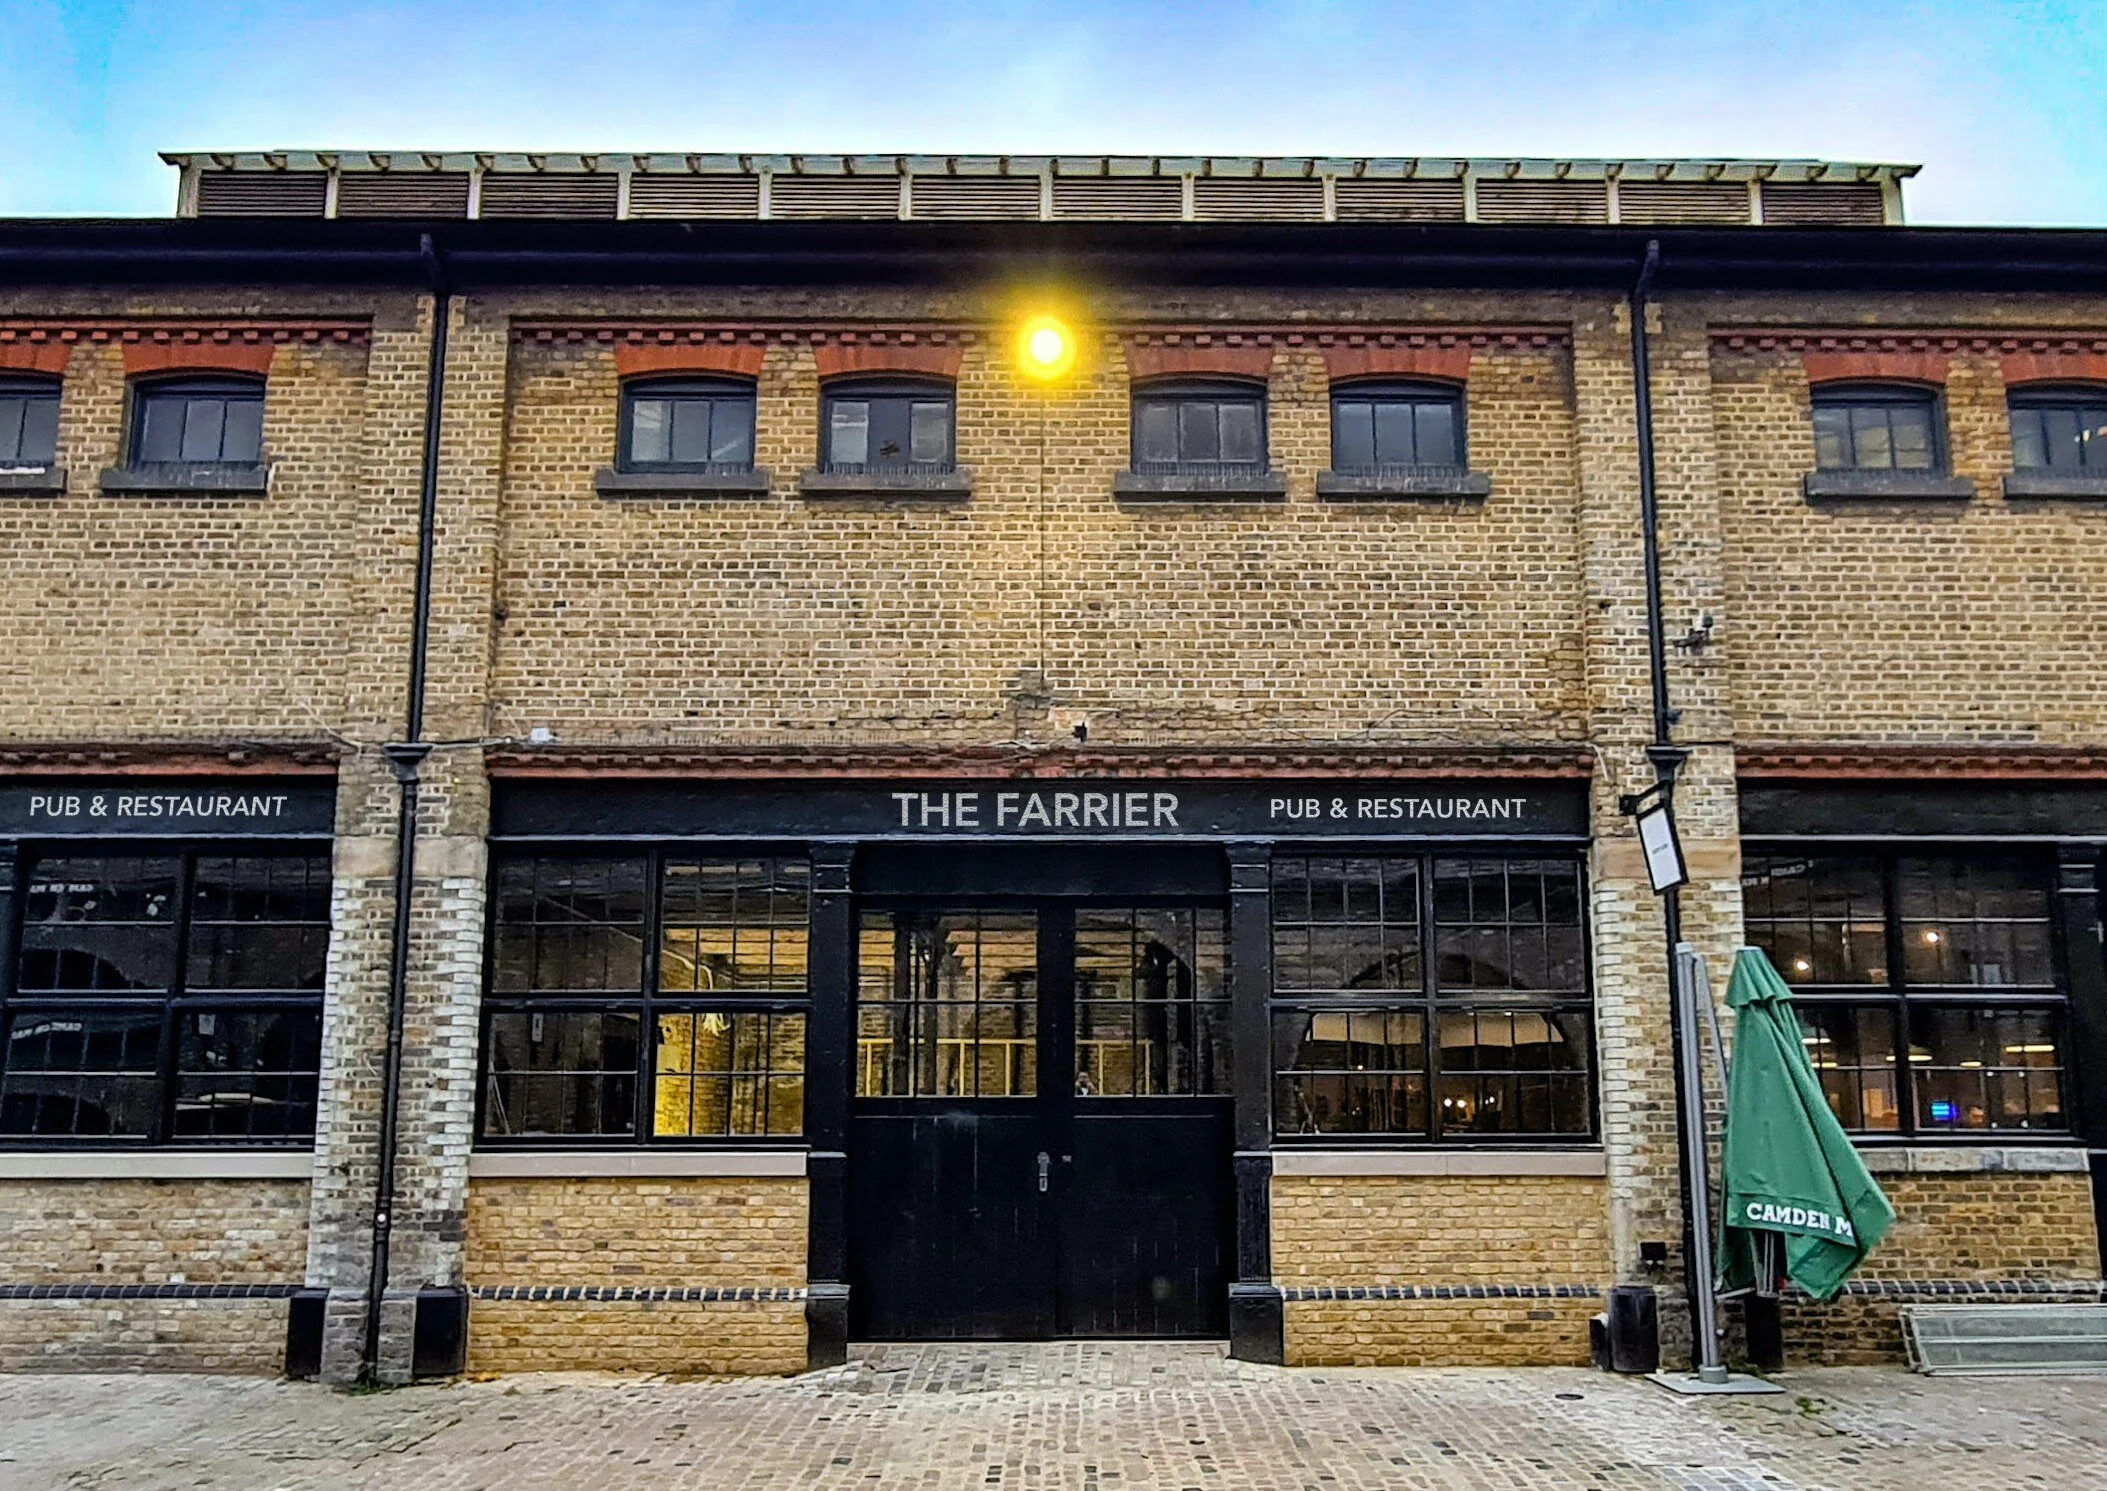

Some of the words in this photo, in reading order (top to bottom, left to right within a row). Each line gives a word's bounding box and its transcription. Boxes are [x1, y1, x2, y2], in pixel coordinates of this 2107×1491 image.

[29, 796, 81, 816] PUB
[89, 796, 108, 816] &
[117, 796, 287, 816] RESTAURANT
[891, 792, 980, 827] THE
[996, 792, 1180, 827] FARRIER
[1270, 798, 1321, 819] PUB
[1329, 798, 1349, 819] &
[1357, 798, 1527, 819] RESTAURANT
[1746, 1202, 1831, 1230] CAMDEN
